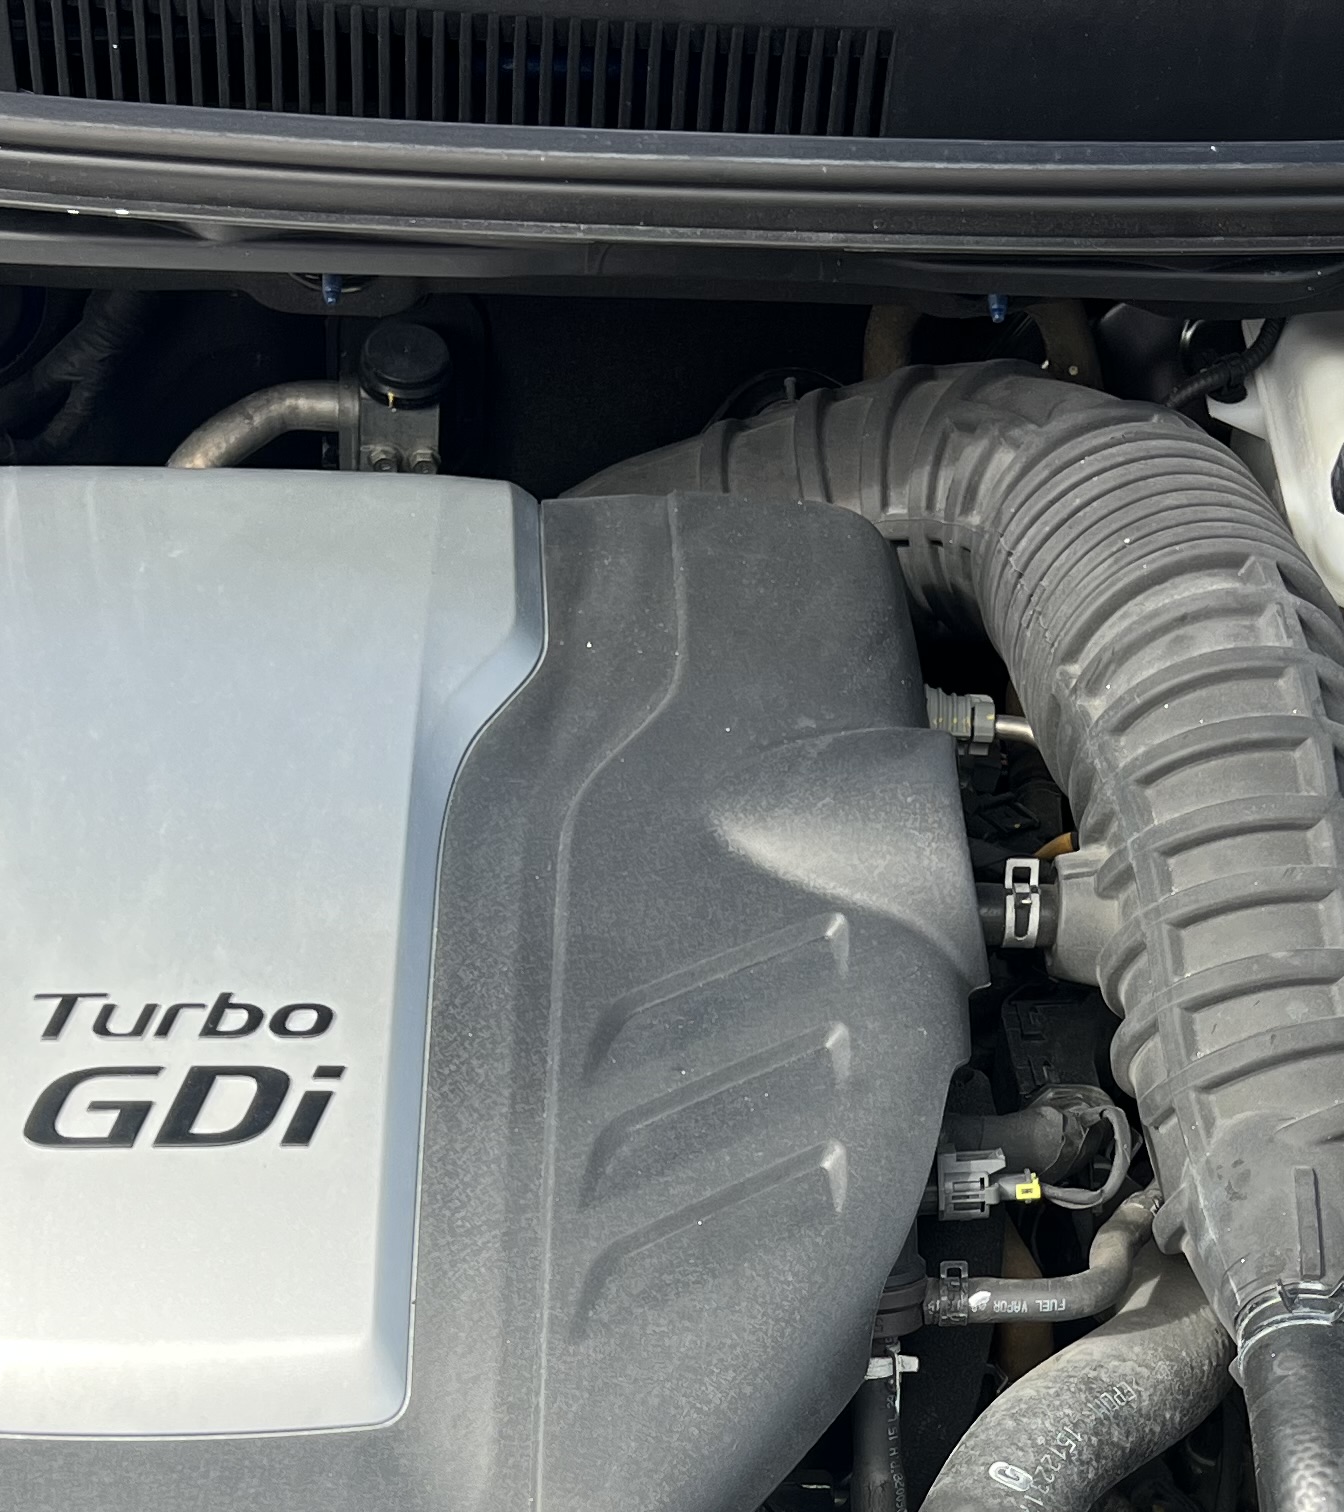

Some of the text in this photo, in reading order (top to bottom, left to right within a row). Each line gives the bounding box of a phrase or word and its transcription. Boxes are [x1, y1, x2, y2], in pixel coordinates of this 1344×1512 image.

[32, 991, 337, 1043] Turbo
[22, 1063, 348, 1150] GDi
[993, 1300, 1028, 1313] VAPOR
[1035, 1298, 1066, 1312] FUEL
